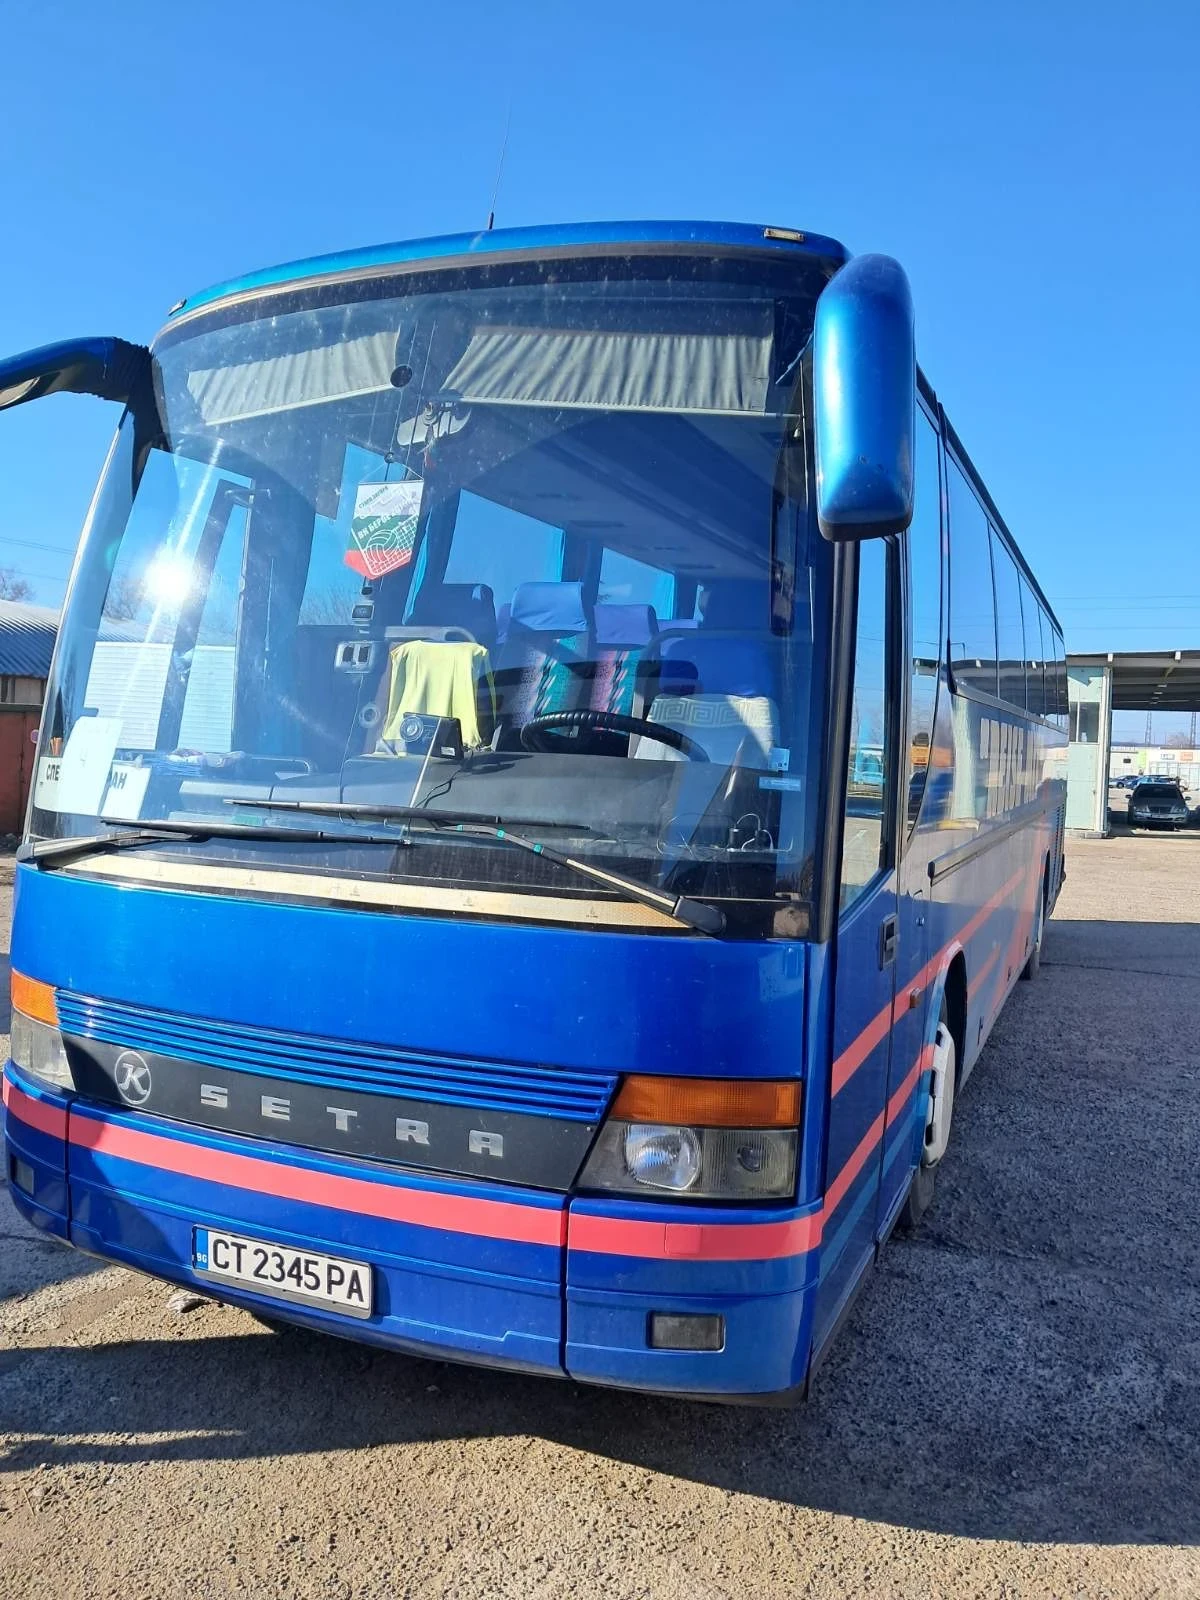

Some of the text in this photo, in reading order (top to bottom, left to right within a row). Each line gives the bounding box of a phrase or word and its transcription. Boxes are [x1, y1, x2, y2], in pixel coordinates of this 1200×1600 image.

[46, 763, 128, 789] СПЕ АН
[200, 1083, 504, 1158] SETRA
[196, 1251, 208, 1264] BG
[212, 1238, 365, 1303] CT 2345 PA
